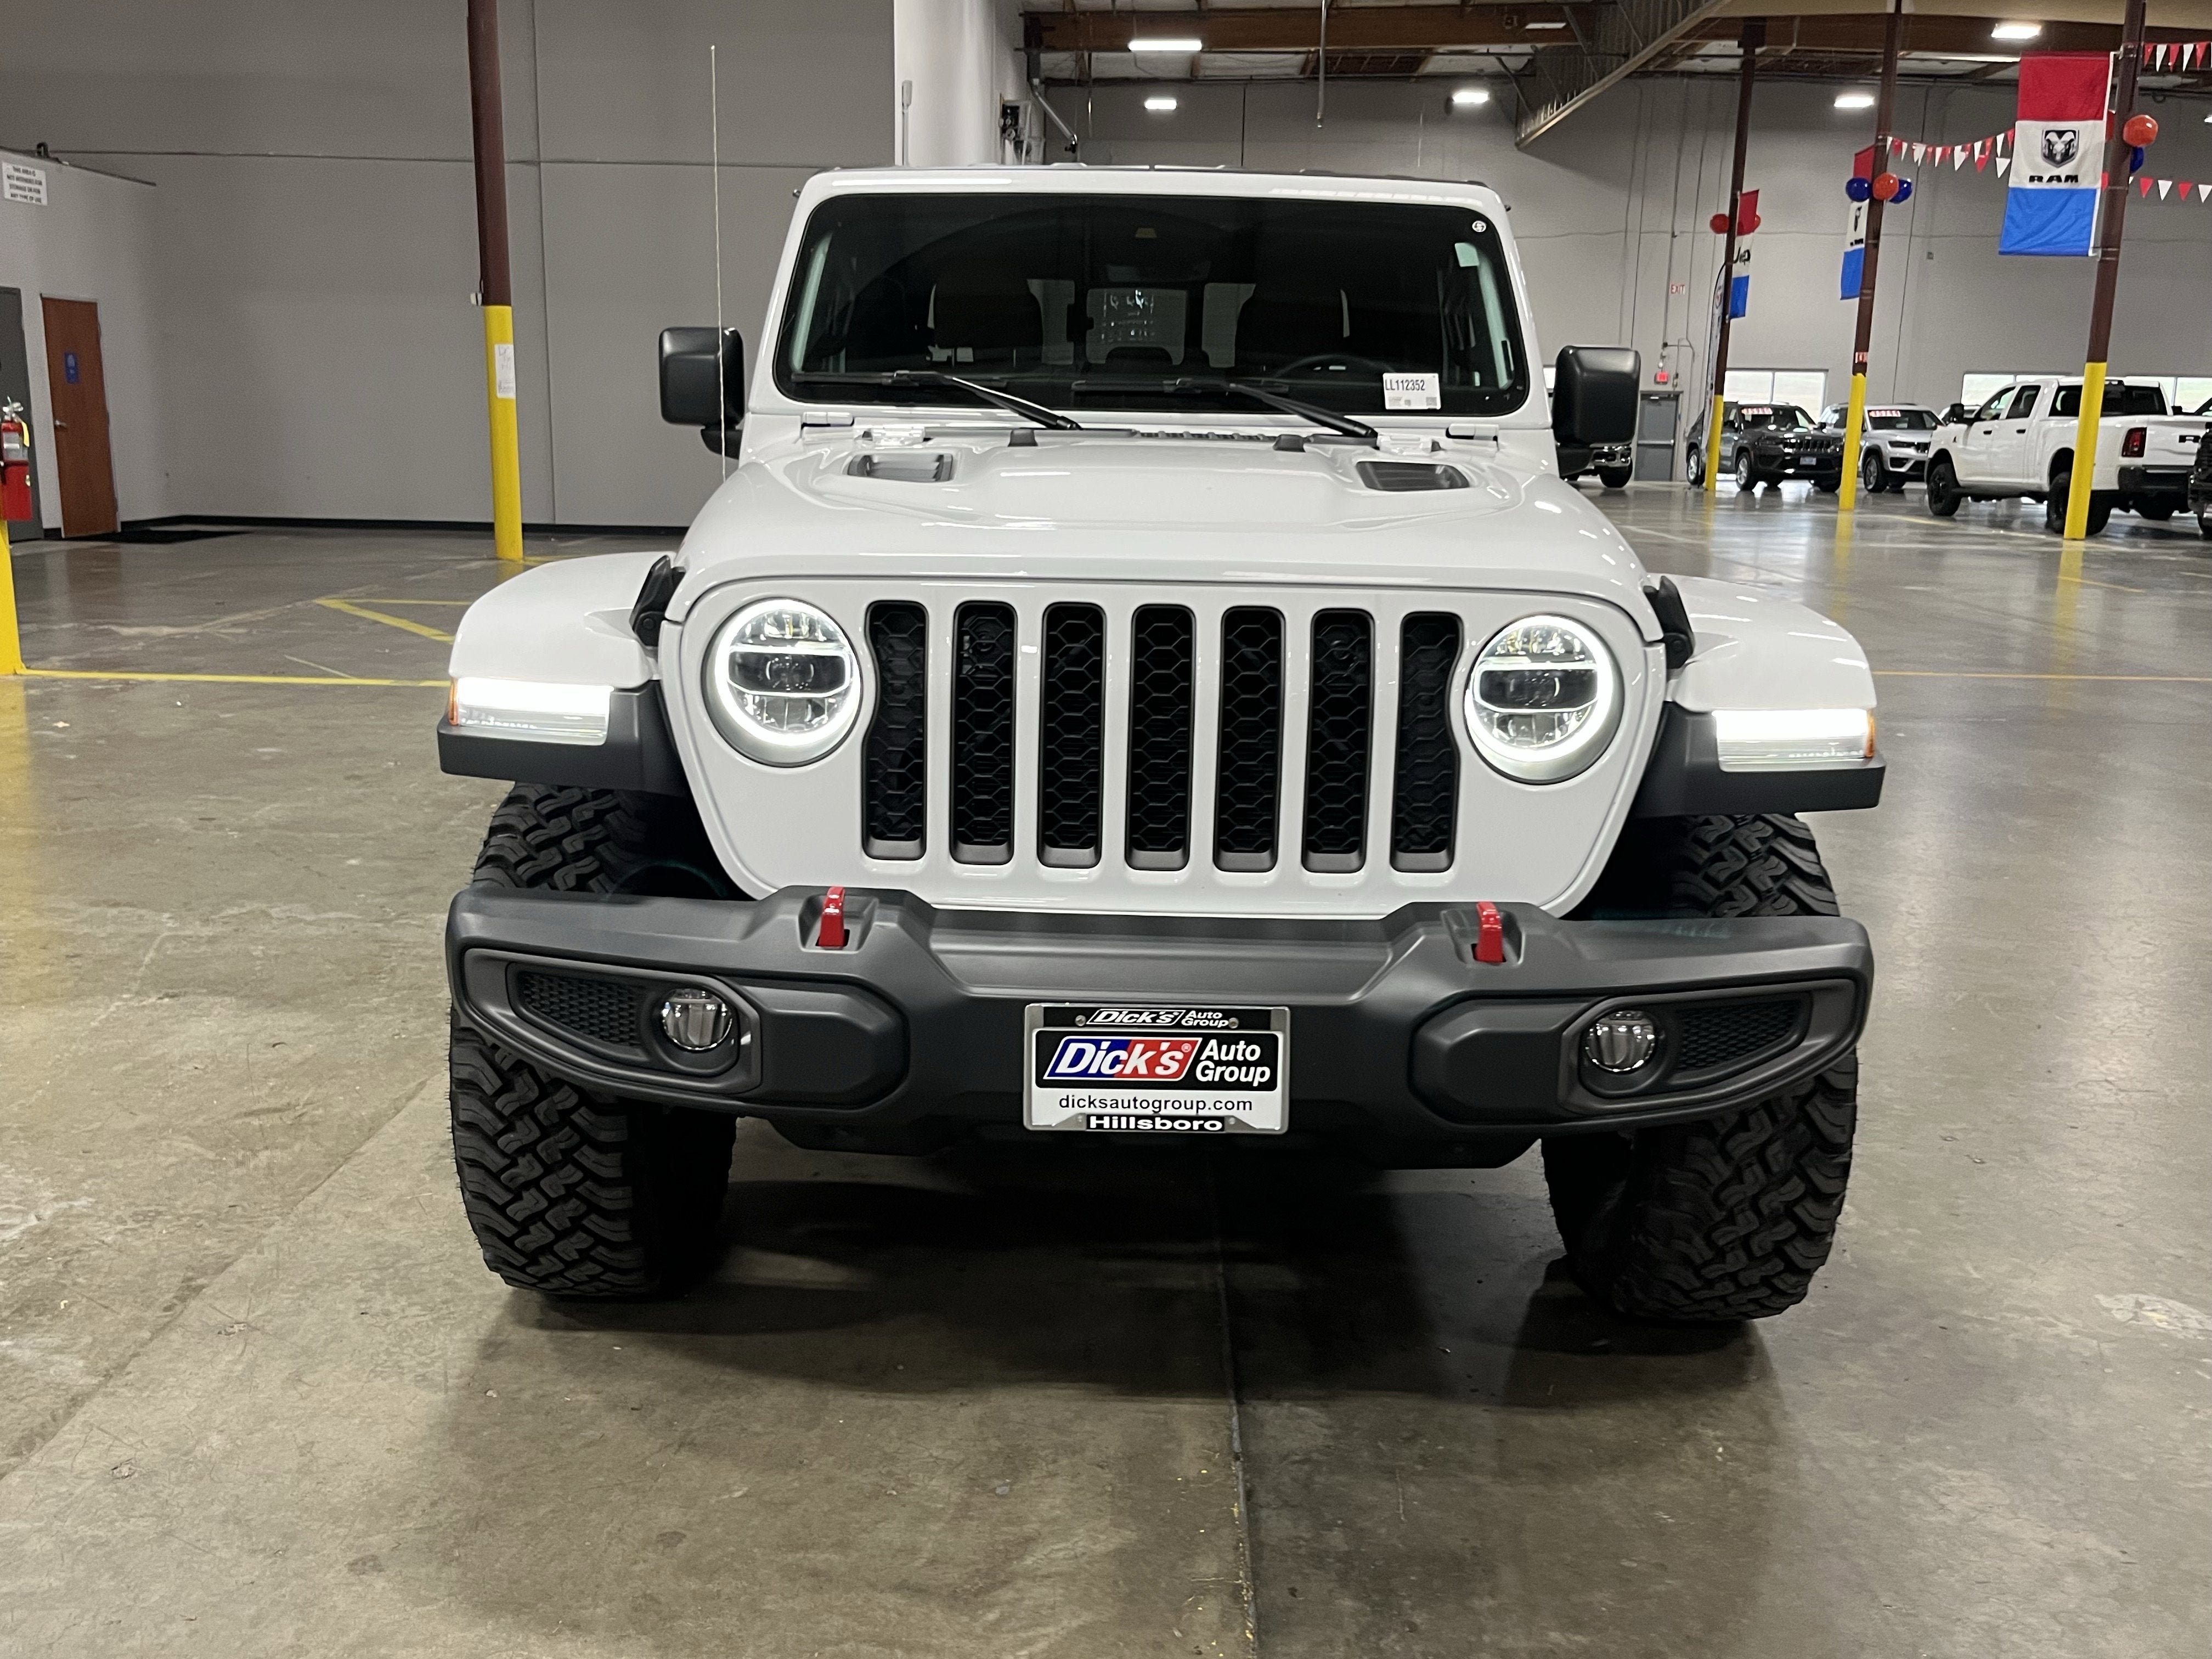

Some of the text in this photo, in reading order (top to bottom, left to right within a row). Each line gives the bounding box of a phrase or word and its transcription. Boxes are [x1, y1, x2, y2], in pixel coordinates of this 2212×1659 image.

[2029, 174, 2079, 183] RAM
[1671, 284, 1685, 294] EXIT
[1385, 379, 1425, 391] LL112352
[1094, 1011, 1176, 1024] Dick's
[1184, 1010, 1223, 1019] Auto
[1181, 1018, 1229, 1028] Group
[1200, 1039, 1261, 1062] Auto
[1054, 1040, 1180, 1076] Dick's
[1195, 1061, 1271, 1086] Group
[1059, 1095, 1252, 1113] dicksautogroup.com
[1089, 1116, 1223, 1131] Hillsboro
